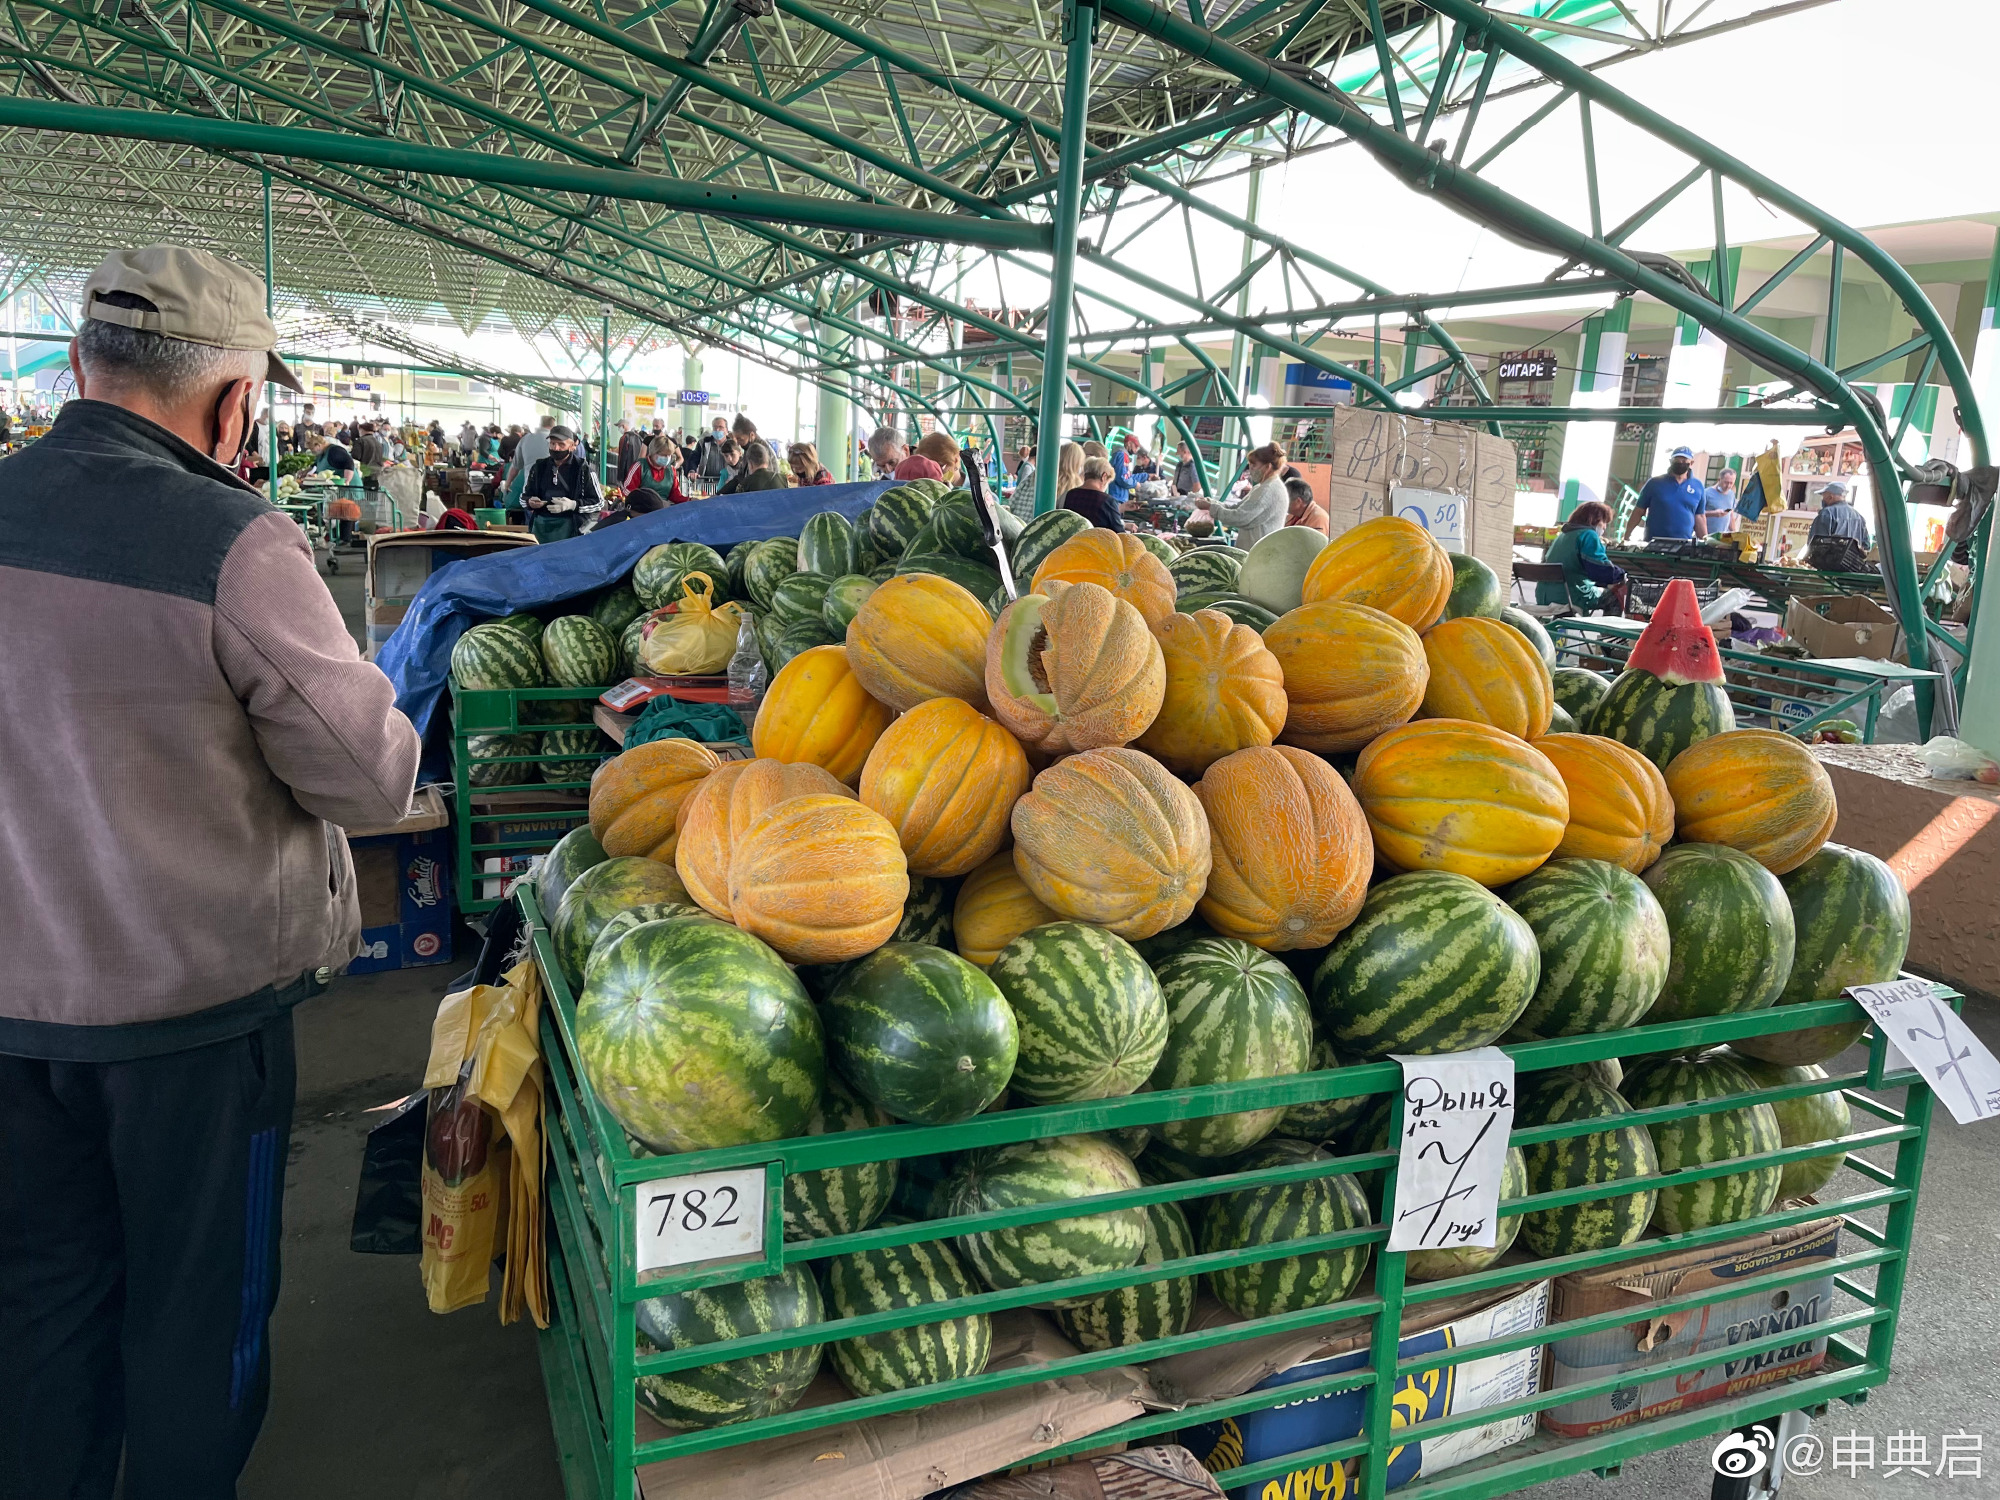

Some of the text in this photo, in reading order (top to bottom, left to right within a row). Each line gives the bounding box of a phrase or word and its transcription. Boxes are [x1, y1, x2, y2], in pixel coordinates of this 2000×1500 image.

[681, 391, 709, 403] 10:59
[1434, 503, 1457, 524] 50
[503, 820, 567, 834] BANANAS
[1907, 998, 1983, 1117] 7
[1399, 1112, 1497, 1246] 7
[648, 1186, 739, 1236] 782
[1437, 1217, 1486, 1247] руб
[1735, 1232, 1836, 1272] PRODUCT OF ECUADOR
[1533, 1284, 1549, 1330] FRES
[1725, 1294, 1820, 1346] DONNA
[1587, 1361, 1812, 1436] PREMIUM BANANAS
